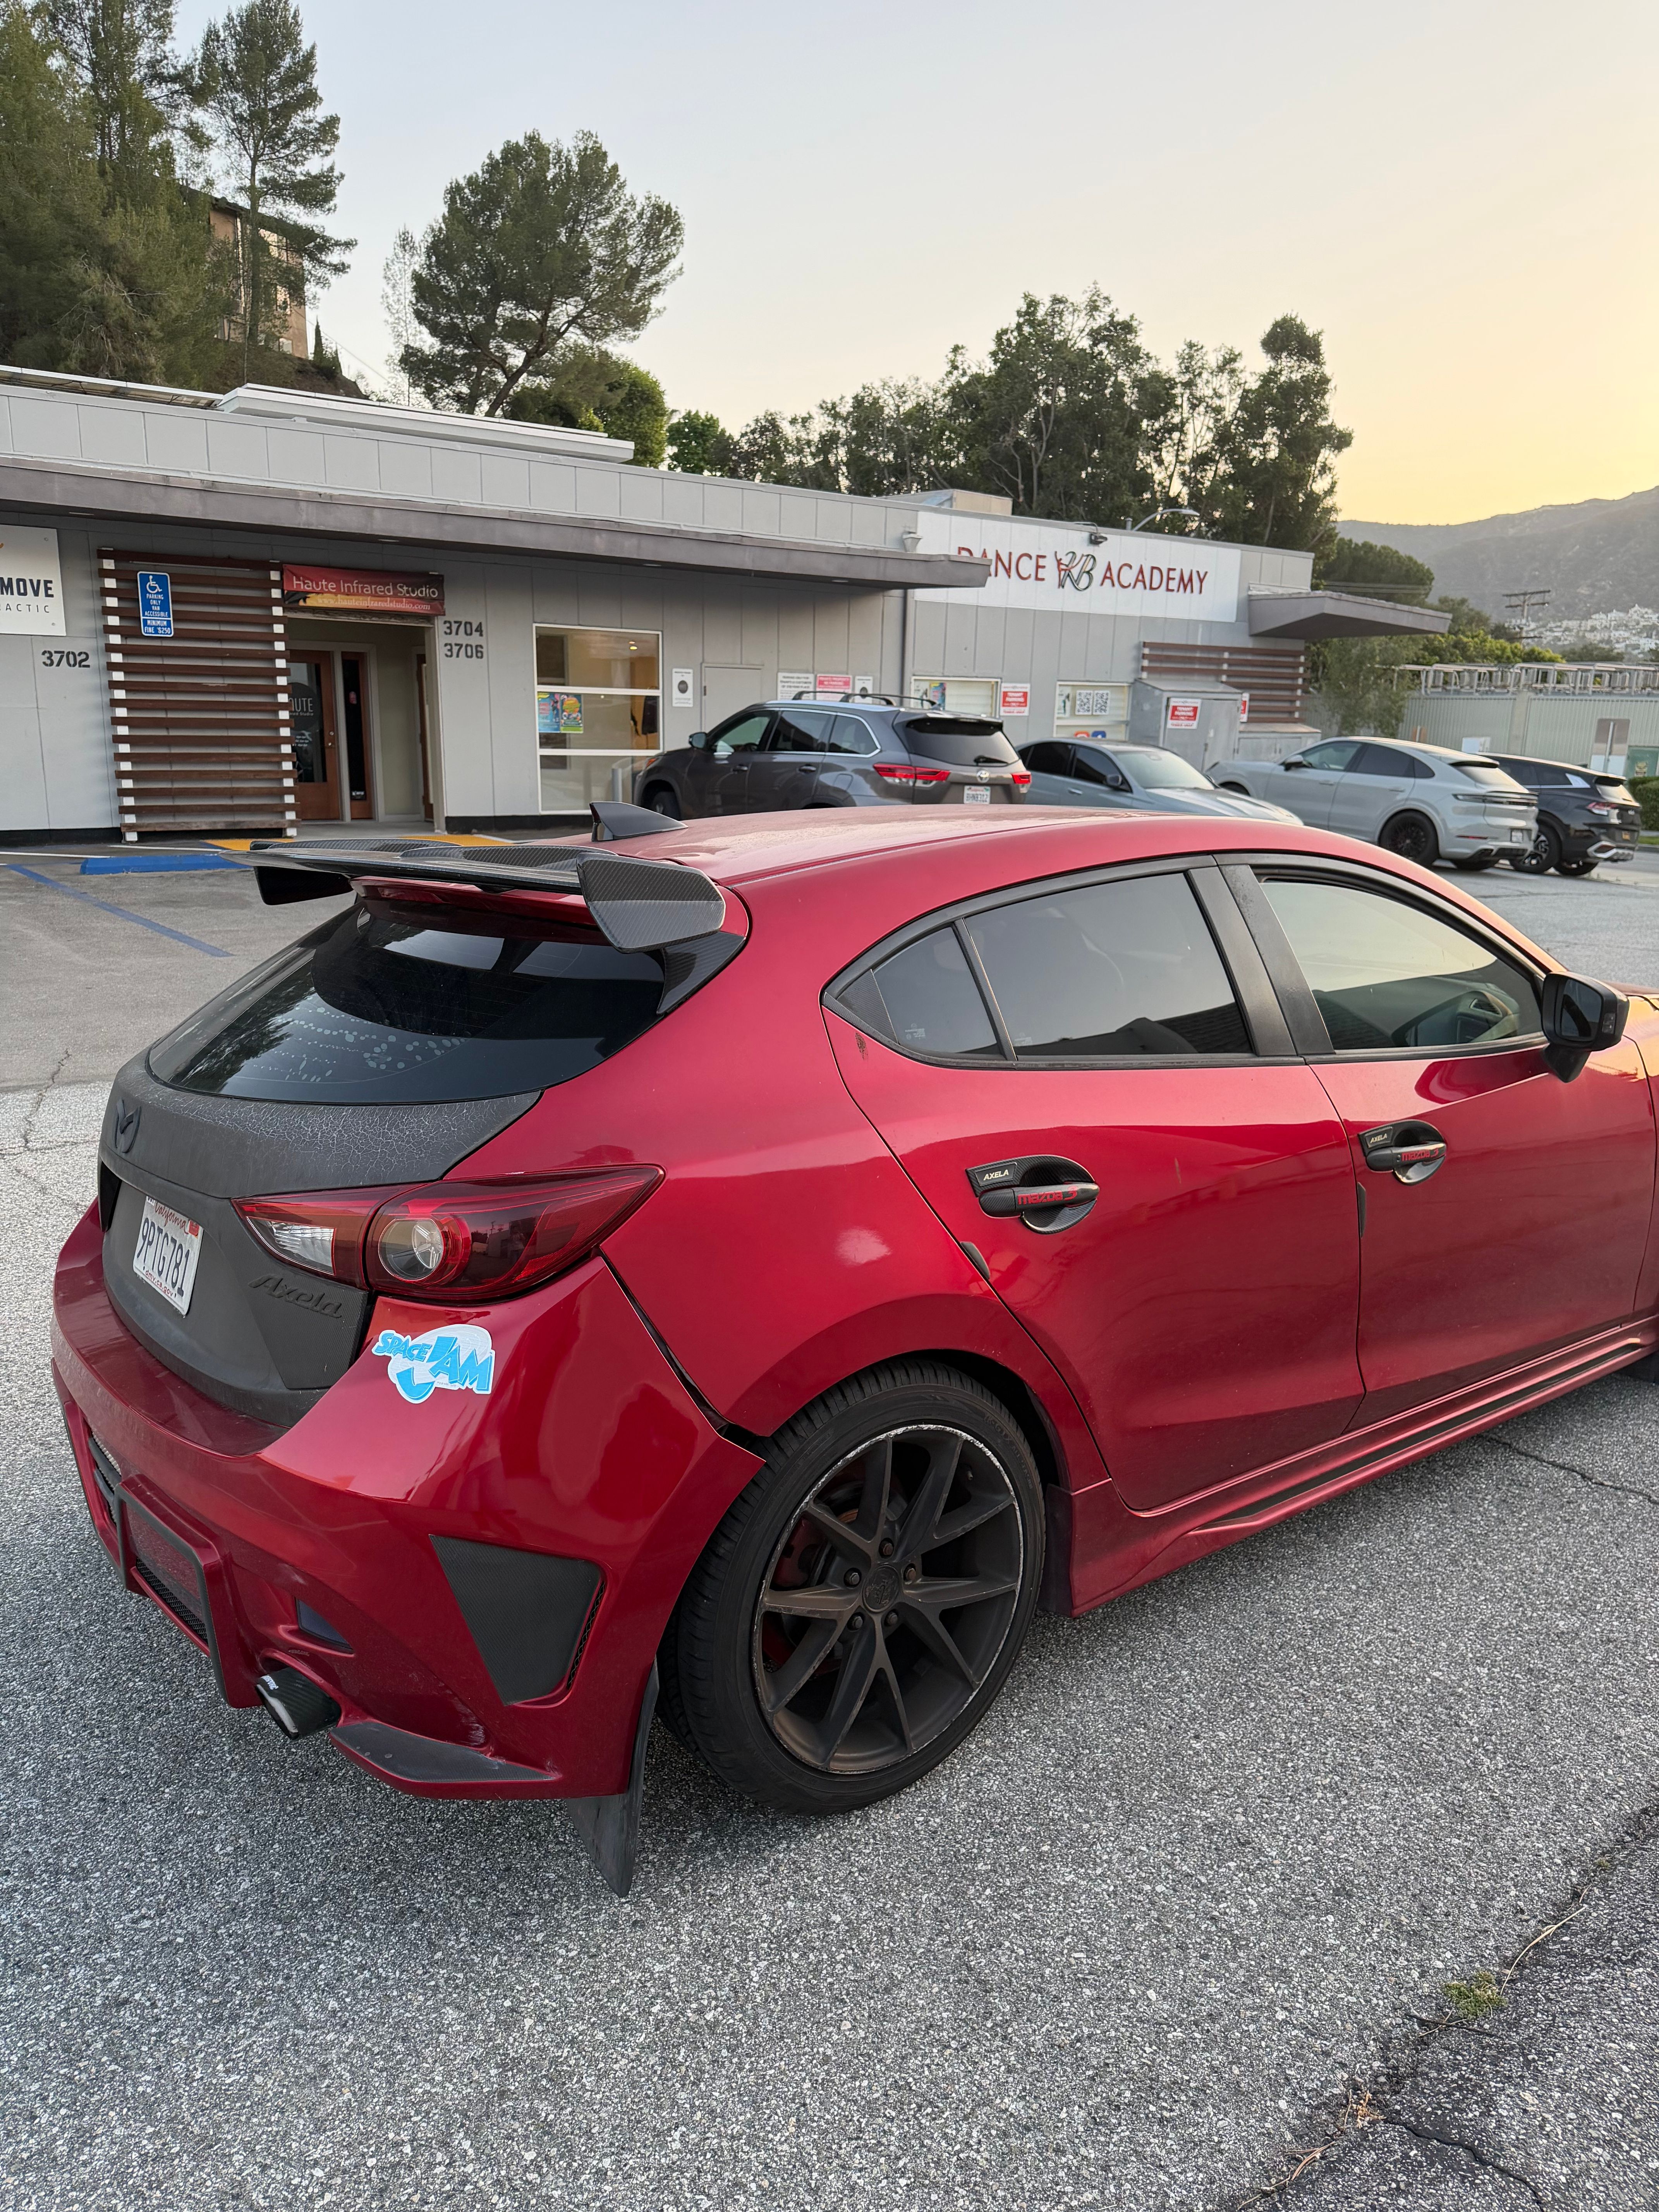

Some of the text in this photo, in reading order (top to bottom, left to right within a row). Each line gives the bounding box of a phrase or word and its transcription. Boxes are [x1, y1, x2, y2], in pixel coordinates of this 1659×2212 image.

[0, 577, 54, 598] MOVE
[293, 576, 438, 598] Haute Infrared Studio
[1100, 560, 1208, 594] ACADEMY
[0, 603, 49, 613] ACTIC
[318, 595, 431, 610] www.hauteinfraredstudio.com
[443, 620, 484, 637] 3704
[41, 650, 90, 668] 3702
[444, 643, 484, 659] 3706
[289, 698, 313, 712] AUTE
[1370, 1133, 1387, 1143] AXELA
[984, 1170, 1009, 1180] AXELA
[155, 1201, 189, 1235] California
[137, 1218, 190, 1297] 9PTG781
[145, 1269, 173, 1297] dmv.ca.gov
[248, 1274, 342, 1318] Axela
[374, 1333, 432, 1362] SPACE
[396, 1336, 493, 1400] JAM
